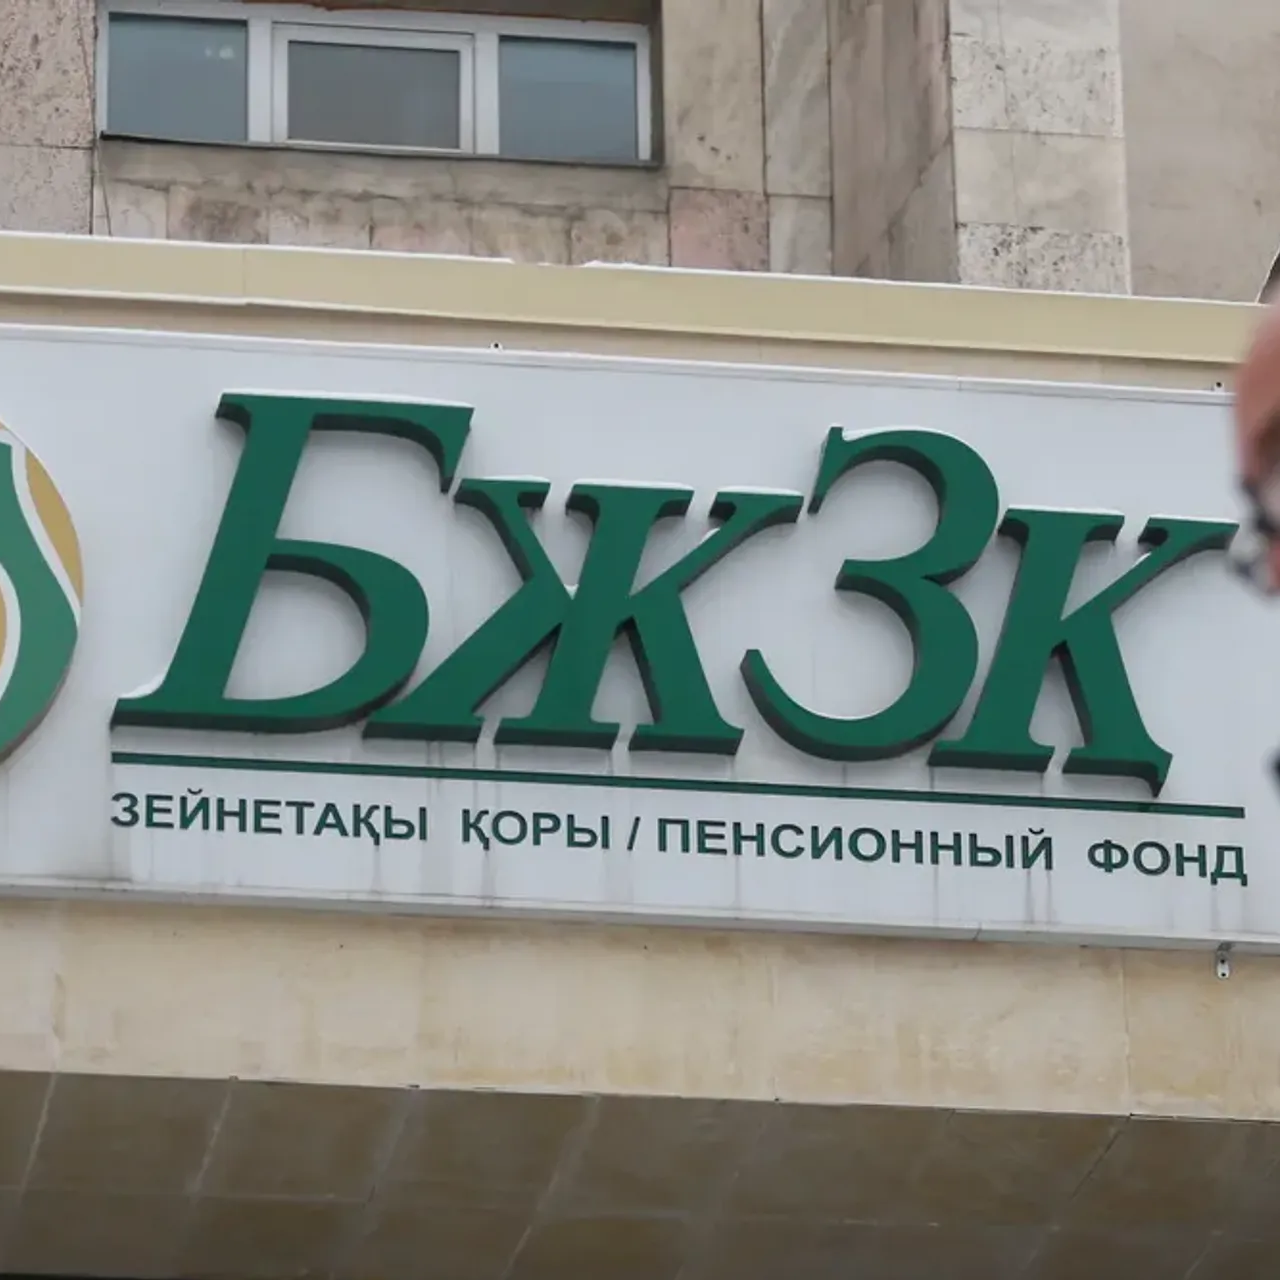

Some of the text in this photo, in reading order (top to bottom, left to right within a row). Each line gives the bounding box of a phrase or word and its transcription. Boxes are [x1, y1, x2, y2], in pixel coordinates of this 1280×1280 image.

[110, 788, 429, 847] ЗЕЙНЕТАҚЫ
[461, 807, 610, 852] ҚОРЫ
[657, 817, 1054, 871] ПЕНСИОННЫЙ
[1087, 838, 1249, 887] ФОНД
